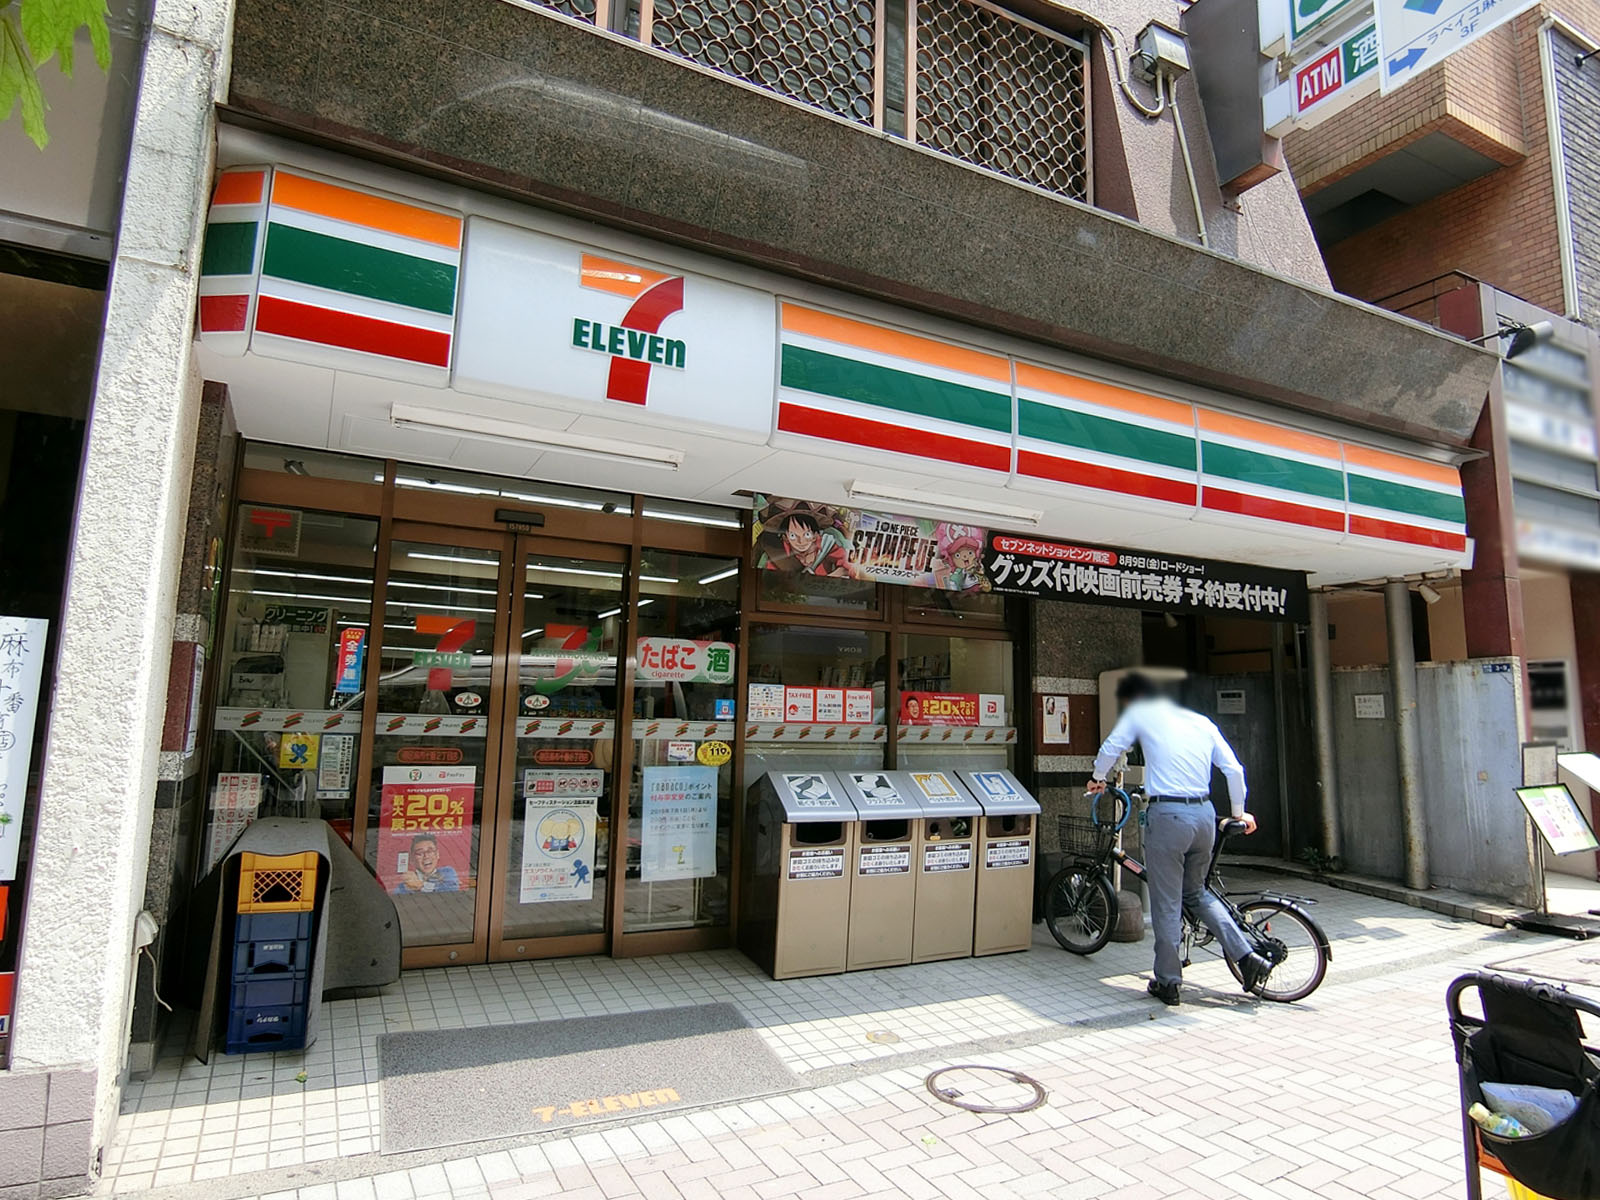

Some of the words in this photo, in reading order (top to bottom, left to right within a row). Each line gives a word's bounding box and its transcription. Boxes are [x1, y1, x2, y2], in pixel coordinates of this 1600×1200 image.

[1460, 19, 1479, 38] 3F
[1300, 52, 1340, 105] ATM
[580, 252, 686, 407] 7
[900, 524, 920, 537] PIECE
[847, 529, 939, 573] STAMPEDE
[1000, 538, 1110, 565] セブンネットショッピング限定
[265, 607, 328, 622] クリーニング
[640, 642, 697, 671] たばこ
[706, 646, 731, 673] 酒
[651, 670, 686, 679] cigarette
[708, 673, 730, 682] liquor
[391, 794, 404, 817] 最大
[406, 794, 465, 817] 20%
[390, 817, 463, 832] 戻ってくる!
